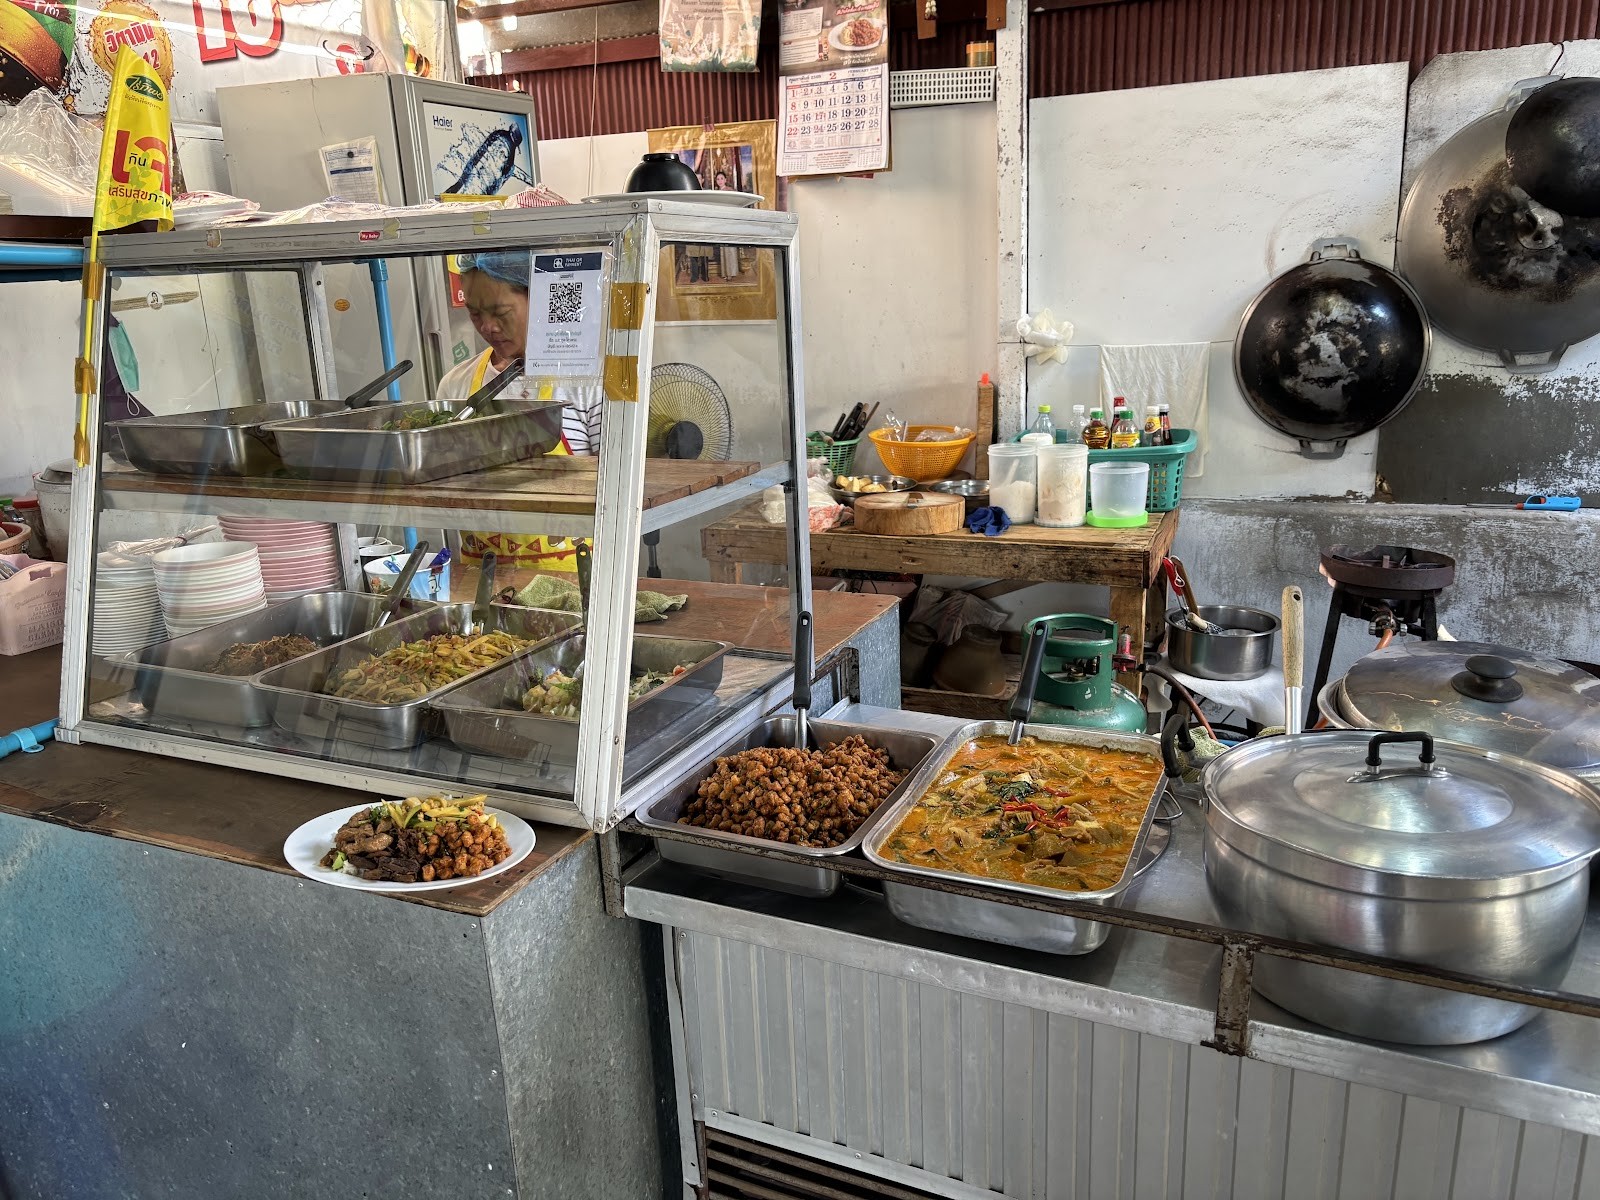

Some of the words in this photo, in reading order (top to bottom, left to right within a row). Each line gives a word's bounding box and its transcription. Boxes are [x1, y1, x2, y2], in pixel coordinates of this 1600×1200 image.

[829, 71, 837, 80] 2
[792, 90, 796, 98] 1
[829, 84, 835, 93] 4
[842, 83, 849, 91] 5
[857, 81, 864, 90] 6
[872, 80, 877, 88] 7
[790, 102, 796, 111] 8
[803, 101, 809, 109] 9
[815, 99, 824, 108] 10
[828, 97, 837, 106] 11
[841, 95, 851, 104] 12
[856, 94, 866, 103] 13
[870, 92, 879, 102] 14
[432, 115, 453, 128] Haier
[789, 115, 798, 123] 15
[802, 113, 811, 122] 16
[828, 110, 838, 119] 18
[841, 109, 851, 118] 19
[854, 107, 866, 117] 20
[869, 106, 879, 115] 21
[787, 127, 798, 136] 22
[800, 126, 811, 135] 23
[814, 125, 823, 134] 24
[826, 123, 837, 132] 25
[840, 122, 851, 131] 26
[854, 120, 866, 130] 27
[868, 119, 879, 128] 28
[128, 152, 147, 167] กิน
